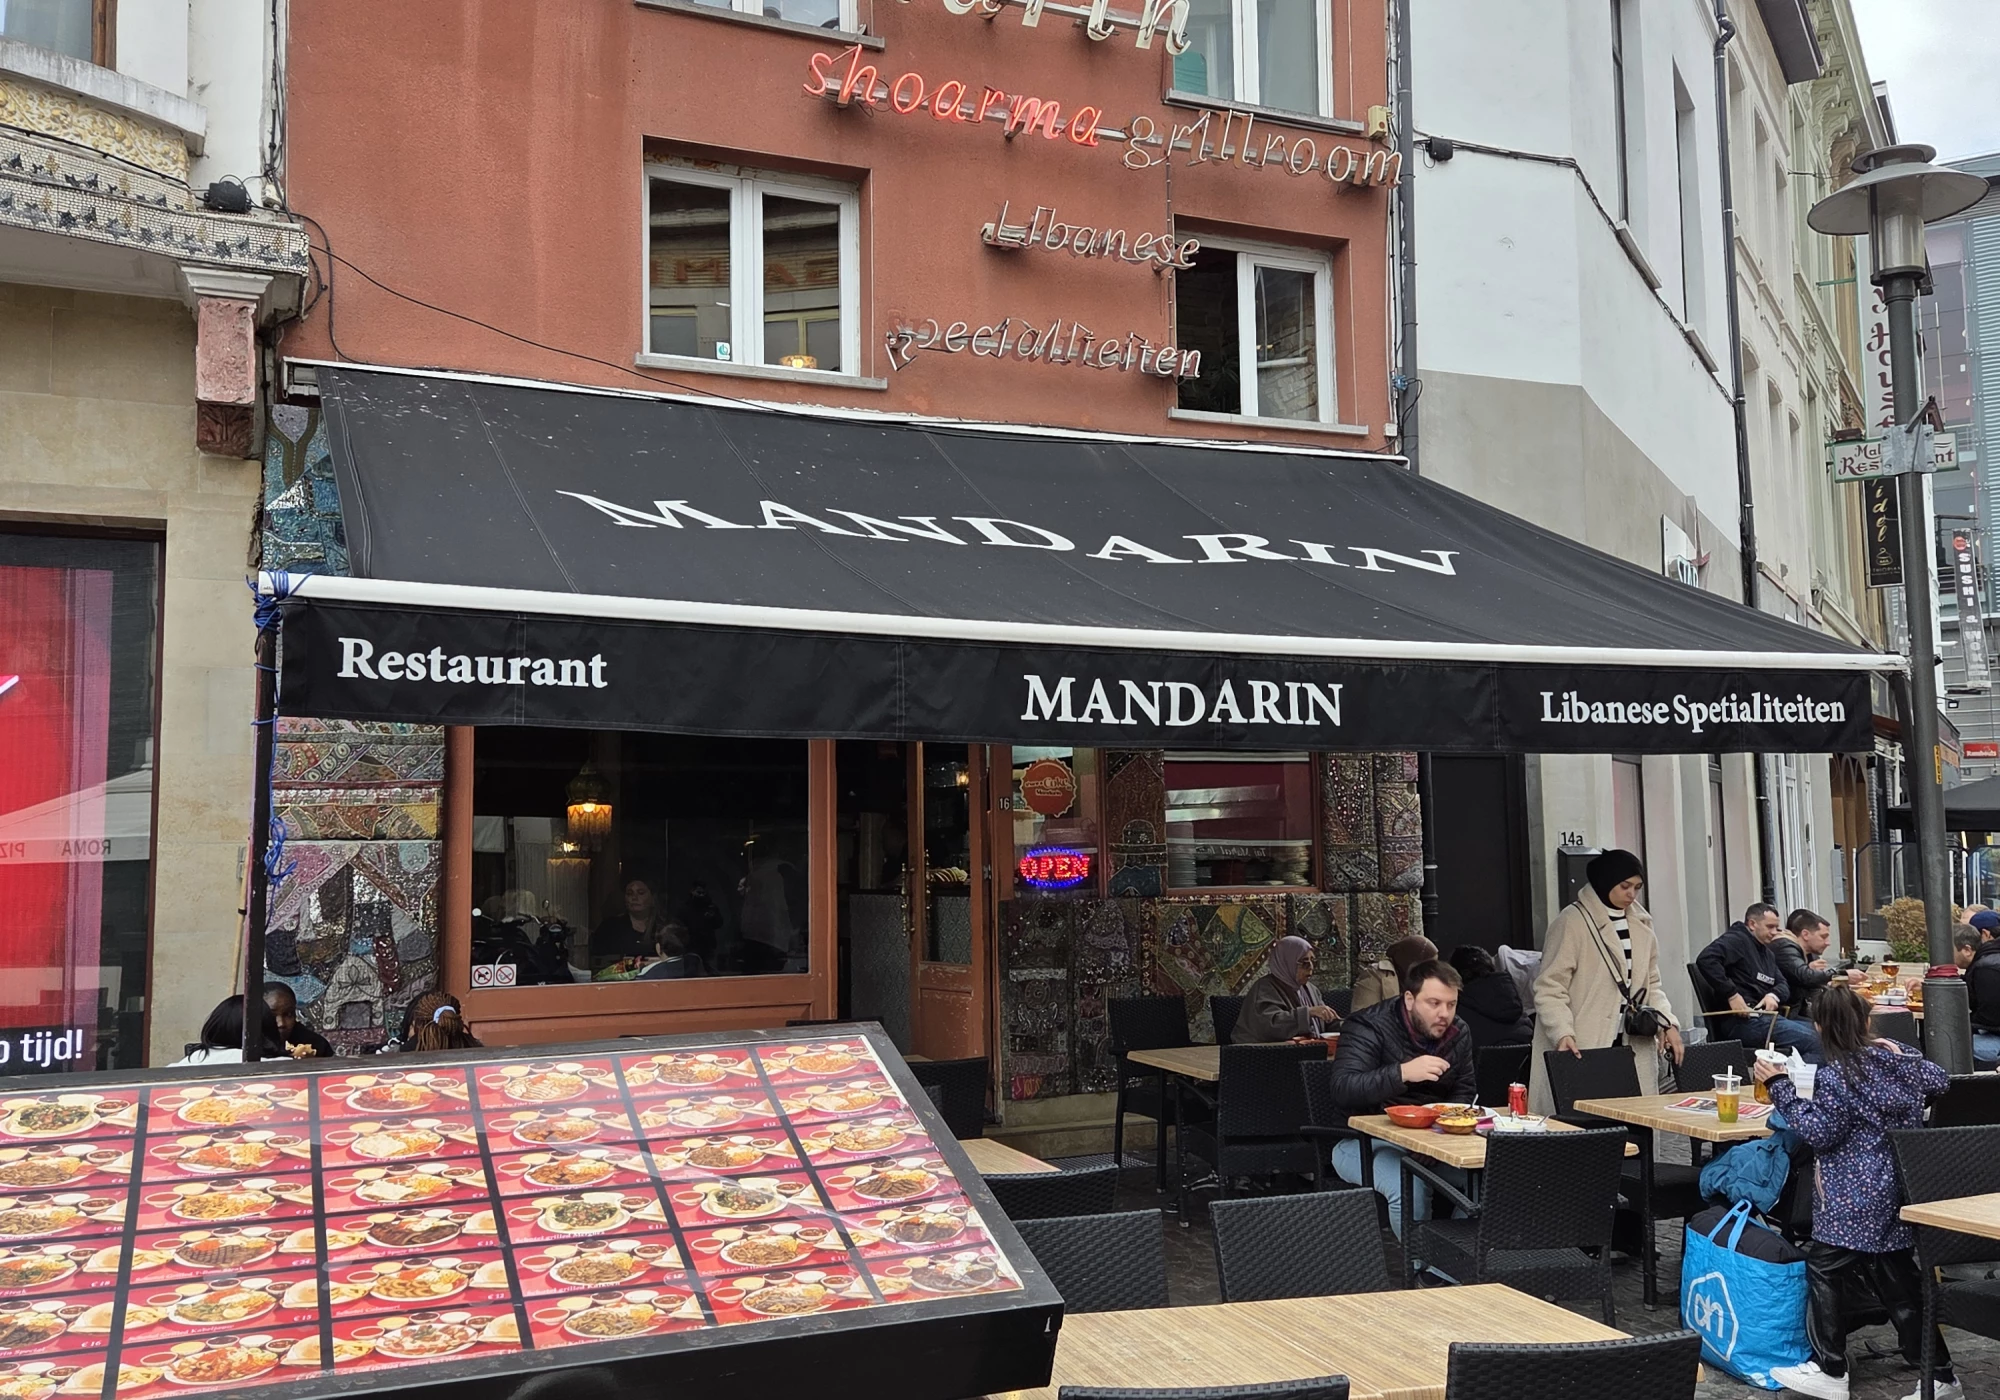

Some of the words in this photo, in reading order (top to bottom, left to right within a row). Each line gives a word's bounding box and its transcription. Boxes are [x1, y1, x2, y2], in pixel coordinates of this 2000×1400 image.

[803, 44, 1101, 147] shoarma
[1122, 107, 1403, 186] grillroom
[996, 200, 1200, 270] Libanese
[555, 489, 1460, 577] MANDARIN
[1871, 478, 1889, 542] idel
[1957, 552, 1975, 606] SUSHI
[336, 636, 608, 689] Restaurant
[1020, 674, 1344, 727] MANDARIN
[1540, 690, 1670, 724] Libanese
[1672, 690, 1846, 734] Spetialiteiten
[999, 797, 1010, 810] 16
[1560, 831, 1584, 846] 14a
[1019, 855, 1090, 879] OPEN
[19, 1028, 84, 1068] tijd!
